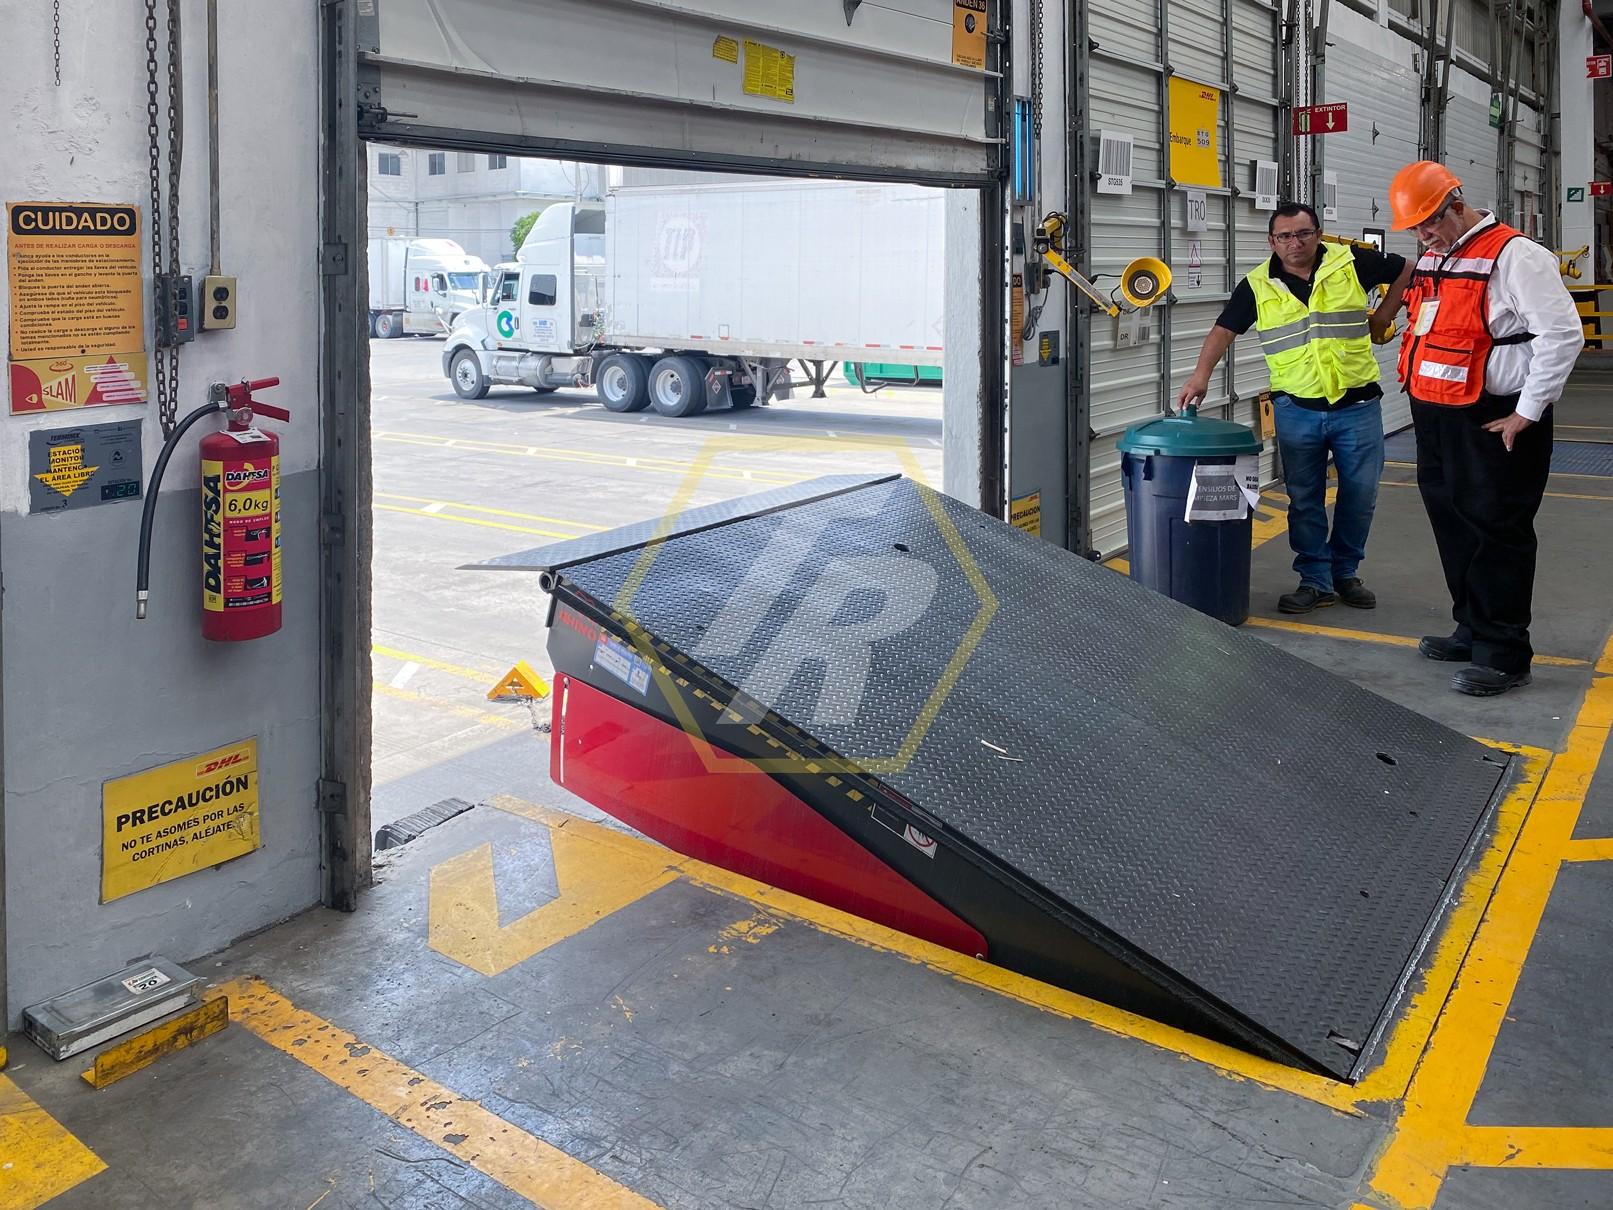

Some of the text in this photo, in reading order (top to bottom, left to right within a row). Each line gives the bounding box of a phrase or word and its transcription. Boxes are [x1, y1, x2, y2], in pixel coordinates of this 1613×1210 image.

[1315, 105, 1346, 113] EXTINTOR
[1170, 132, 1192, 148] Embarque
[18, 210, 131, 231] CUIDADO
[1188, 199, 1206, 221] TRO
[42, 374, 76, 404] SLAM
[74, 470, 94, 478] LIBRE
[204, 753, 242, 774] DHL
[116, 774, 248, 832] PRECAUCIÓN
[122, 802, 244, 852] NO TE ASOMES POR LAS
